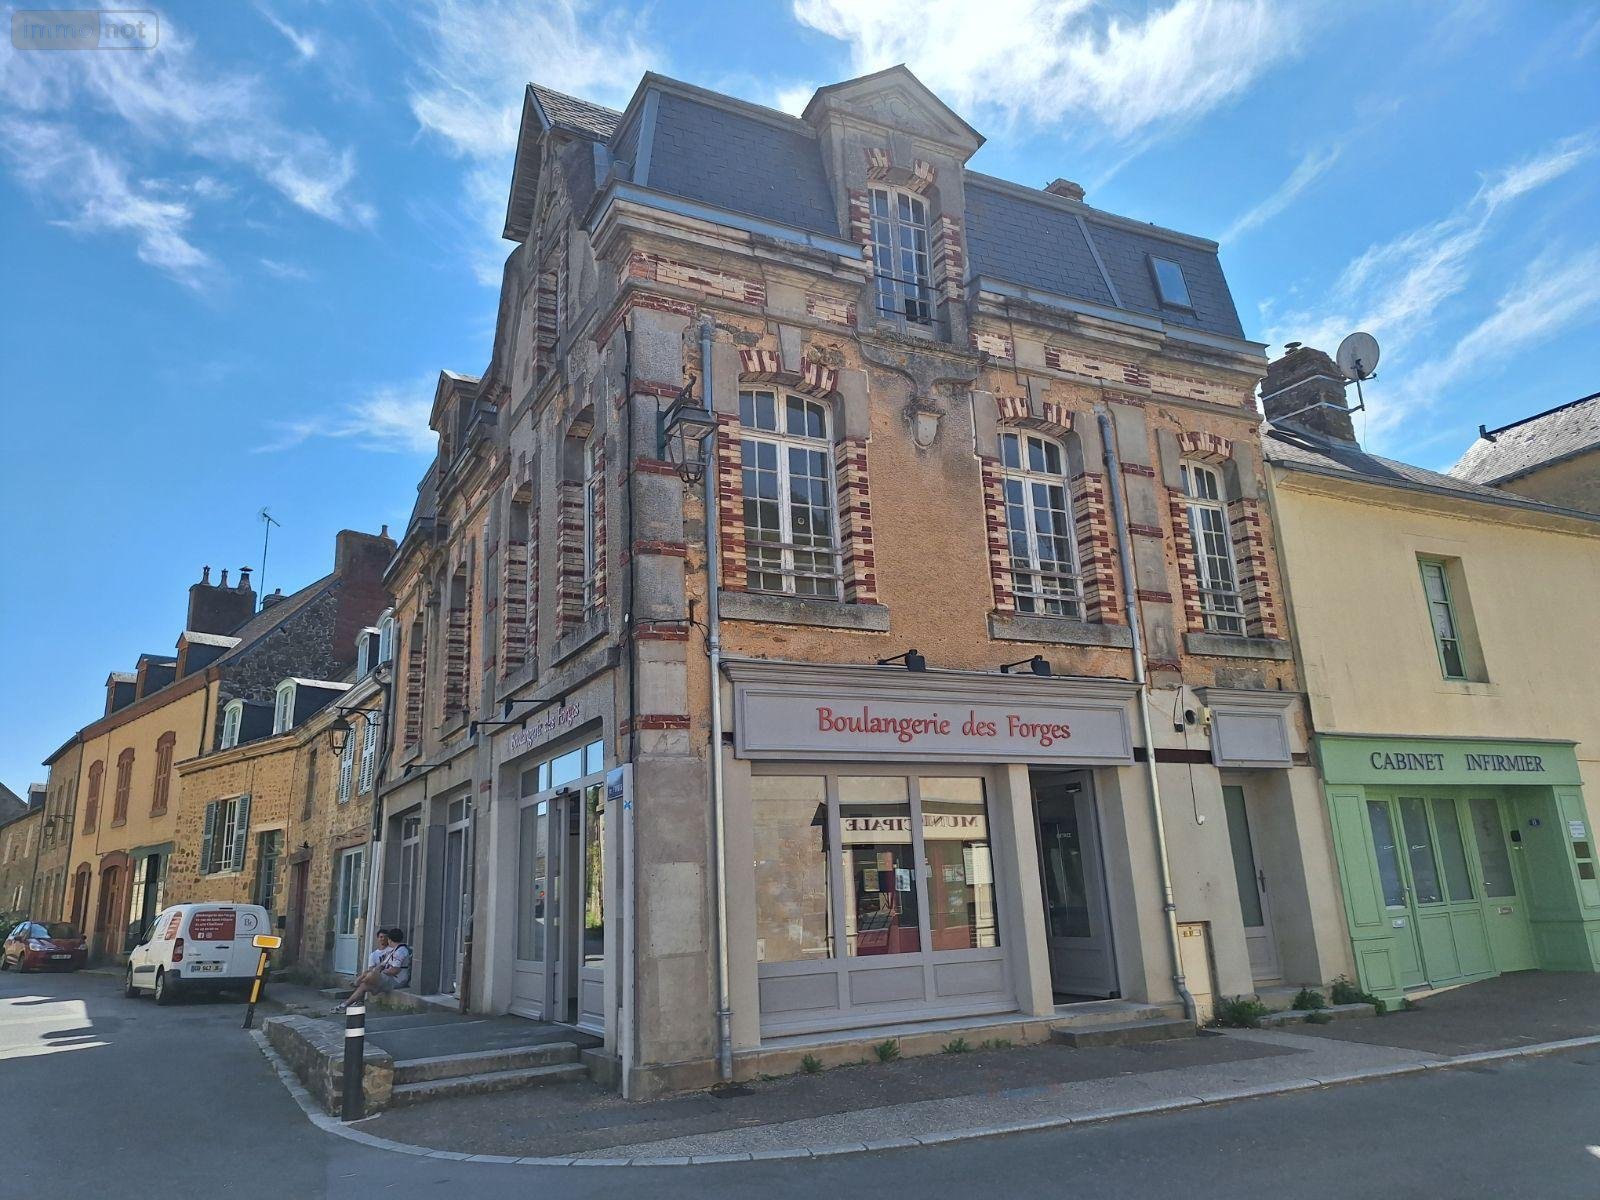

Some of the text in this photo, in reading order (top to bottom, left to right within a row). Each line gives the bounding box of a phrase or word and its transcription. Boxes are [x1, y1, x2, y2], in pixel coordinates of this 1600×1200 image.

[816, 706, 1072, 746] Boulangerie des Forges
[1370, 752, 1546, 772] CABINET INFIRMIER
